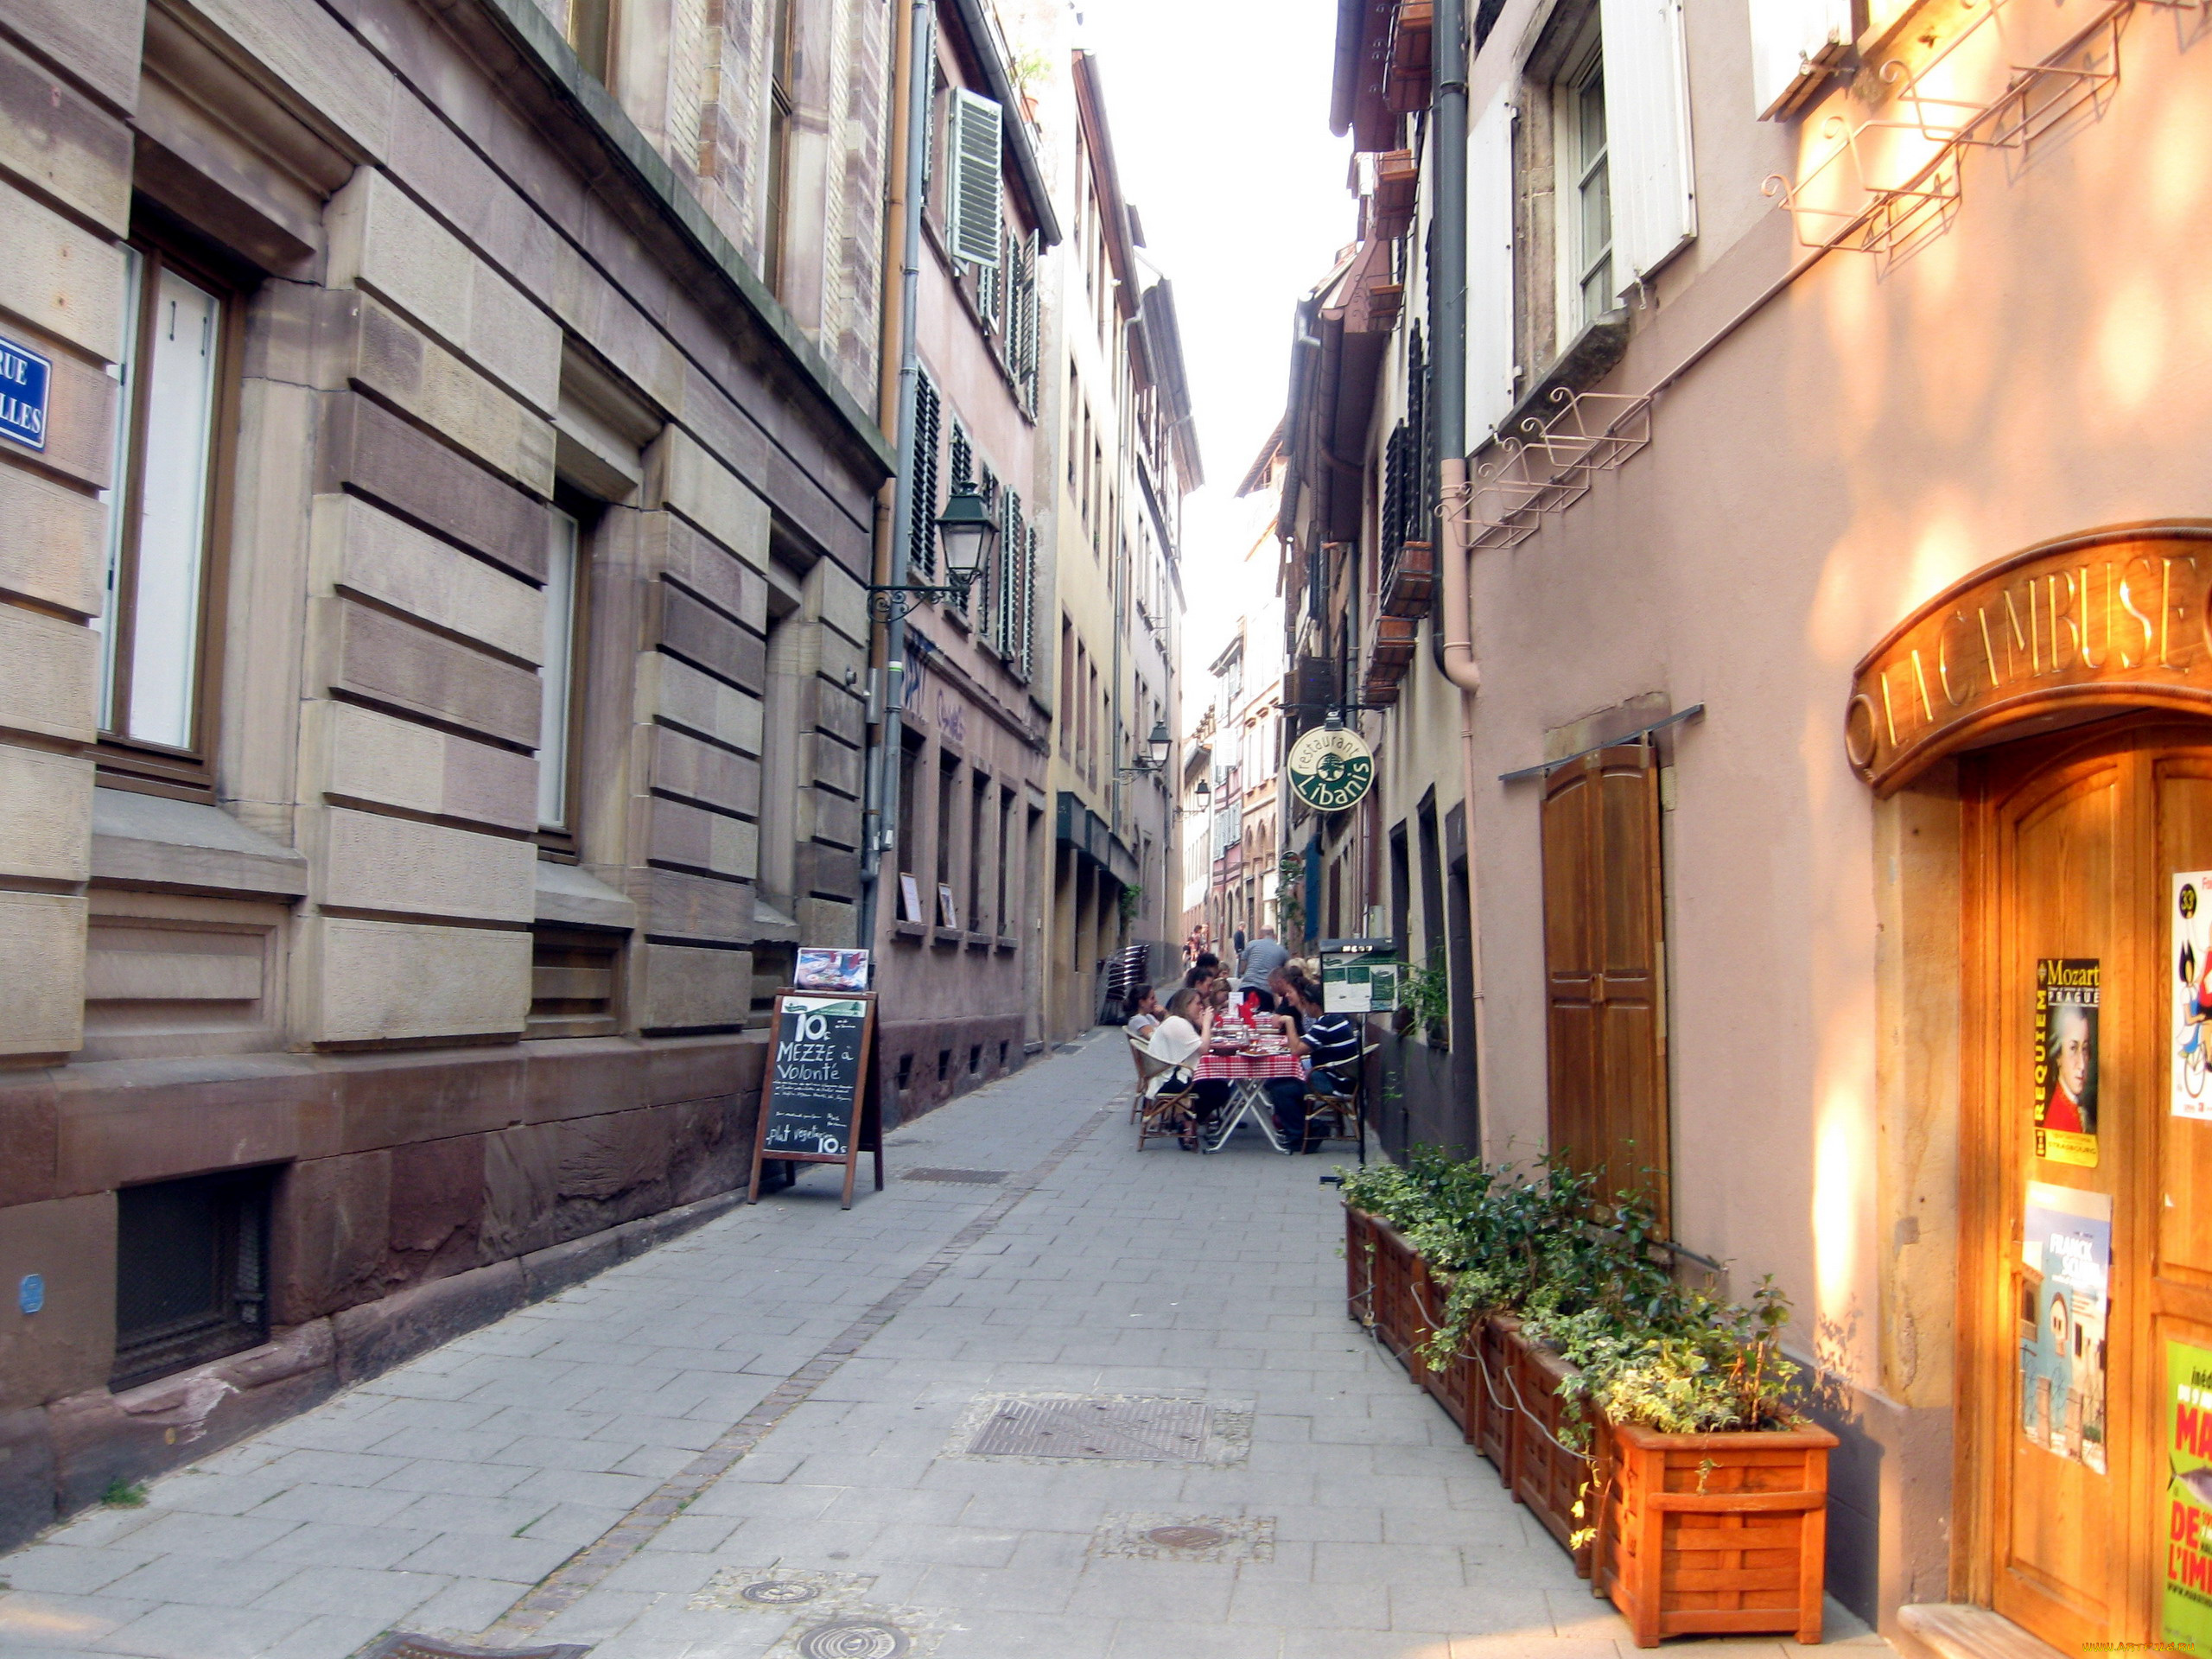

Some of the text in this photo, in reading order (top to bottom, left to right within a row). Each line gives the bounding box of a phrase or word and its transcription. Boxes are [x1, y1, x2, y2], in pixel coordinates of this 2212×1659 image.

[1879, 556, 2197, 750] LA CAMBUSE
[1298, 735, 1360, 770] restaurant
[1297, 762, 1370, 806] Libanis
[2047, 960, 2101, 987] Mozart
[2047, 991, 2100, 1003] PRAGUE
[776, 1040, 855, 1063] MEZZE à
[2034, 989, 2048, 1122] REQUIEM
[766, 1124, 791, 1146] plat
[2171, 1499, 2201, 1549] DE
